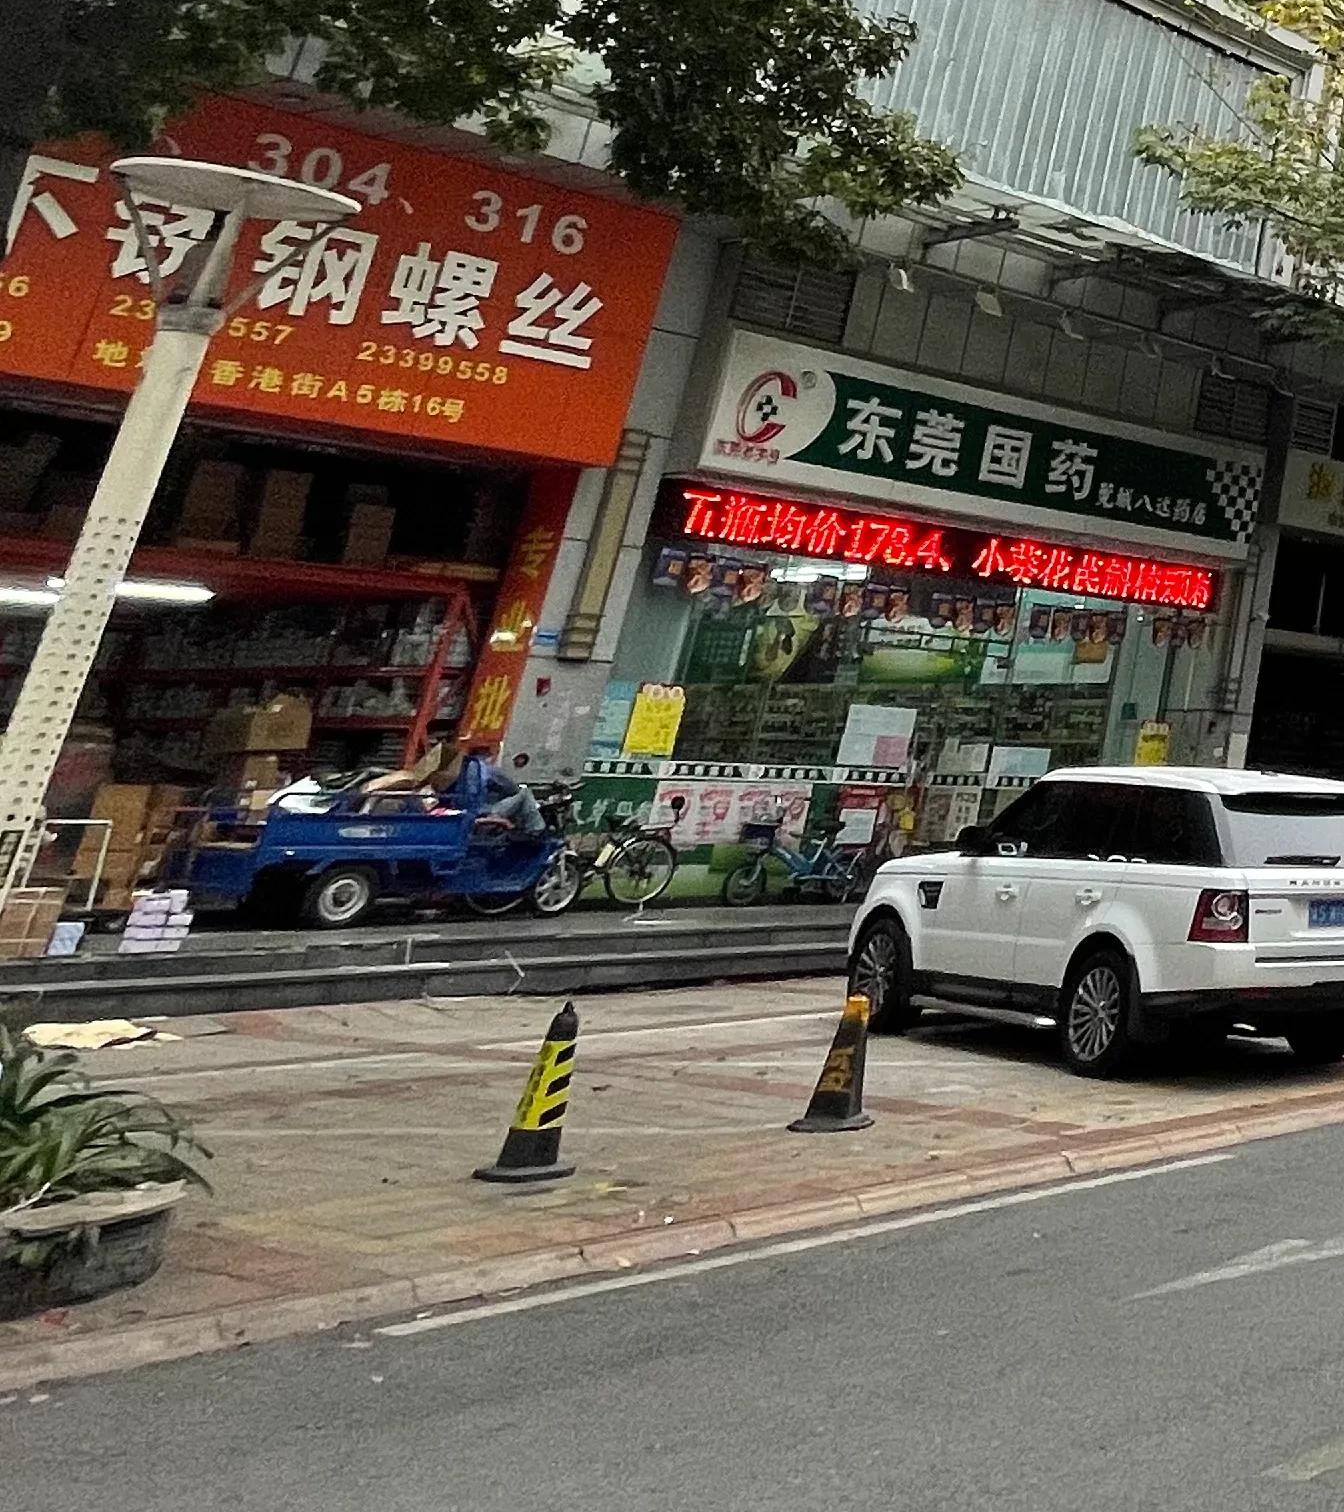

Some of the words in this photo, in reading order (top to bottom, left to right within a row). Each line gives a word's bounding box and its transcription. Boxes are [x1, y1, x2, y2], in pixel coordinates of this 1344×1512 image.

[355, 341, 509, 386] 23399558
[837, 396, 1099, 500] 东莞国药
